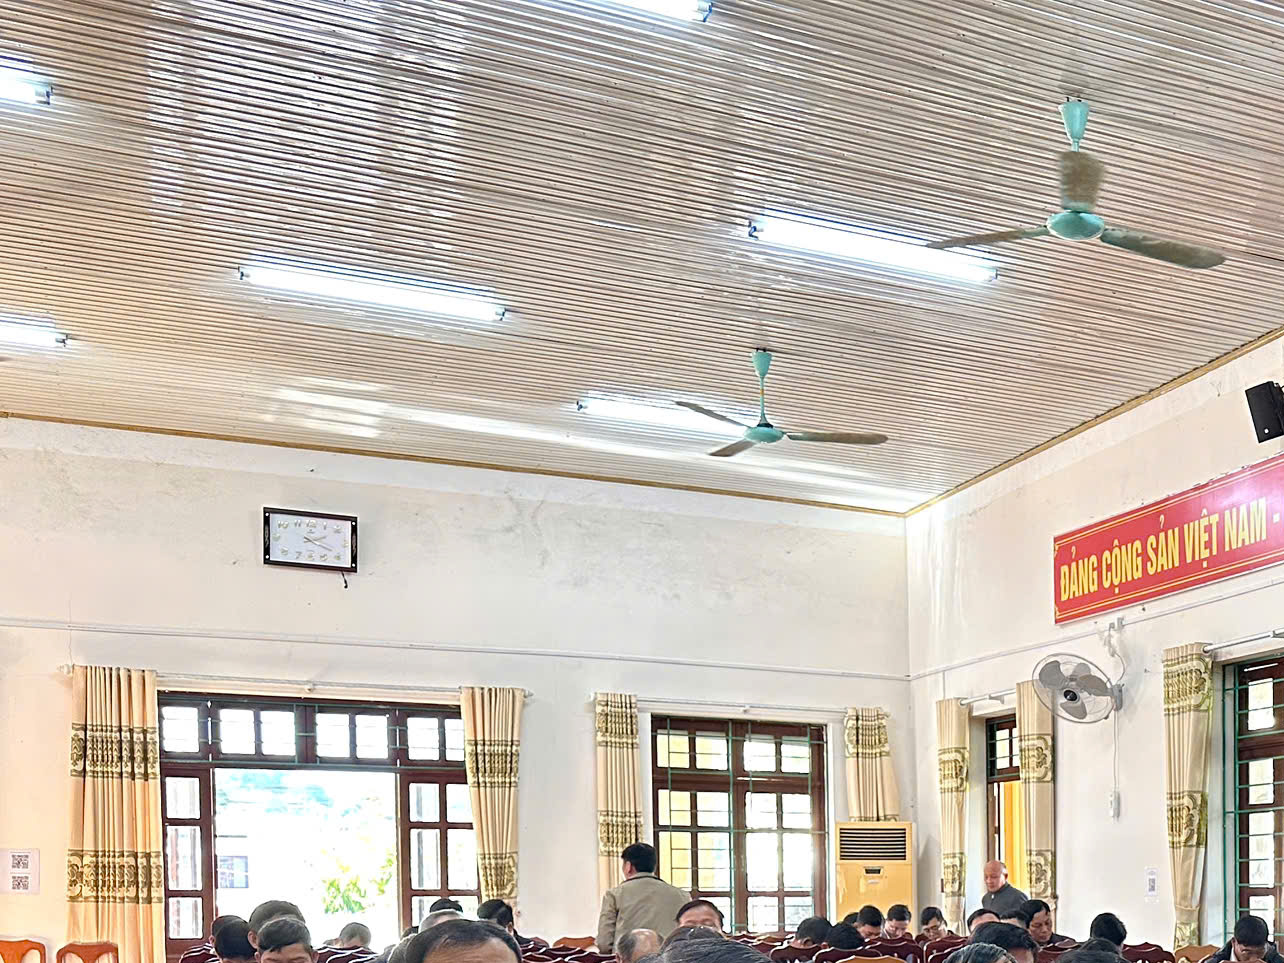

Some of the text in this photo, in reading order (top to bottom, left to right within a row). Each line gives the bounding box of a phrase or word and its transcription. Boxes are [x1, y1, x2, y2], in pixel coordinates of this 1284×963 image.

[1060, 546, 1098, 601] ĐẢNG
[1102, 539, 1142, 594] CỘNG
[1147, 515, 1179, 575] SẢN
[1184, 509, 1219, 568] VIỆT
[1224, 499, 1267, 552] NAM
